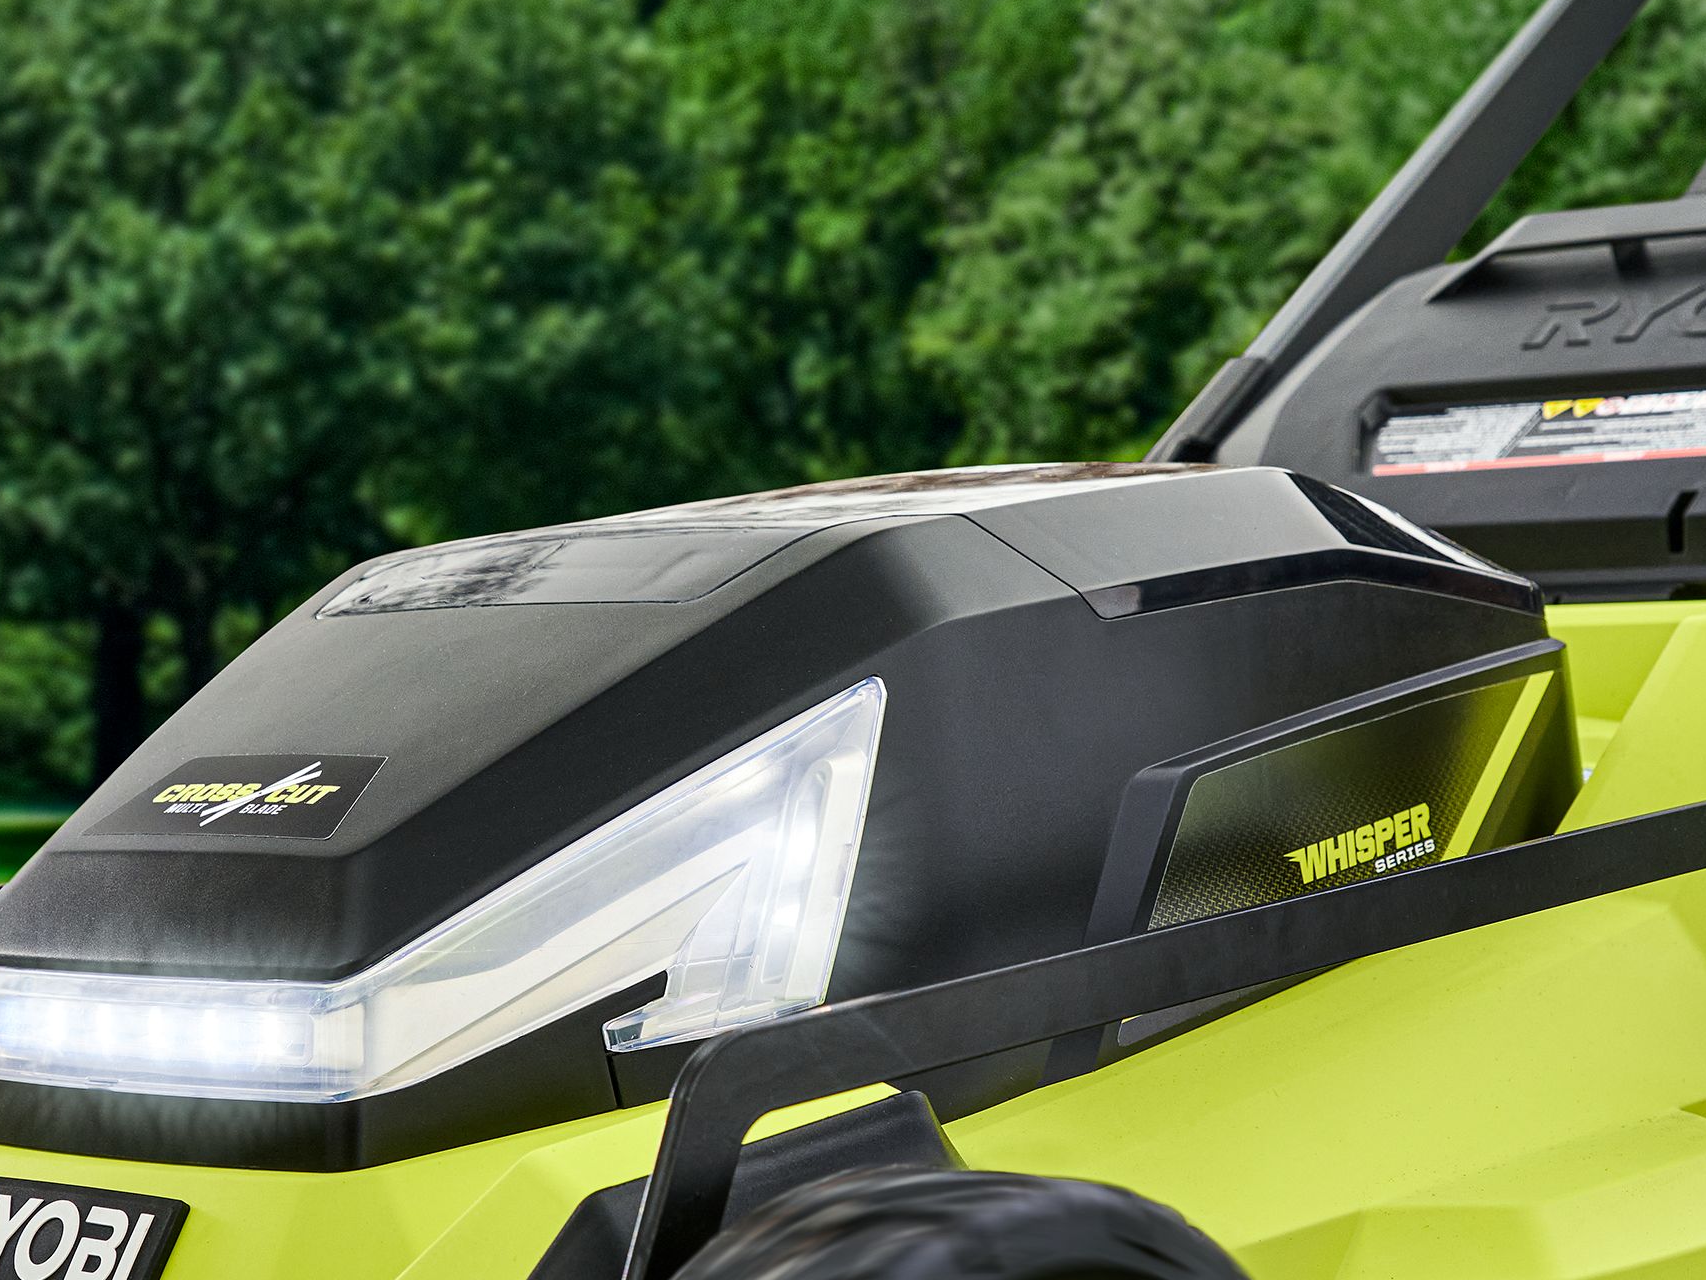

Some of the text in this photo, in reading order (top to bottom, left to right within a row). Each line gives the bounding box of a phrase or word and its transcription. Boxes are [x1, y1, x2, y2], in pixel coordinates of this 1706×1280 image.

[152, 783, 341, 805] CROSS CUT
[163, 803, 288, 815] MULTI BLADE
[1283, 802, 1432, 884] WHISPER
[1374, 838, 1436, 873] SERIES
